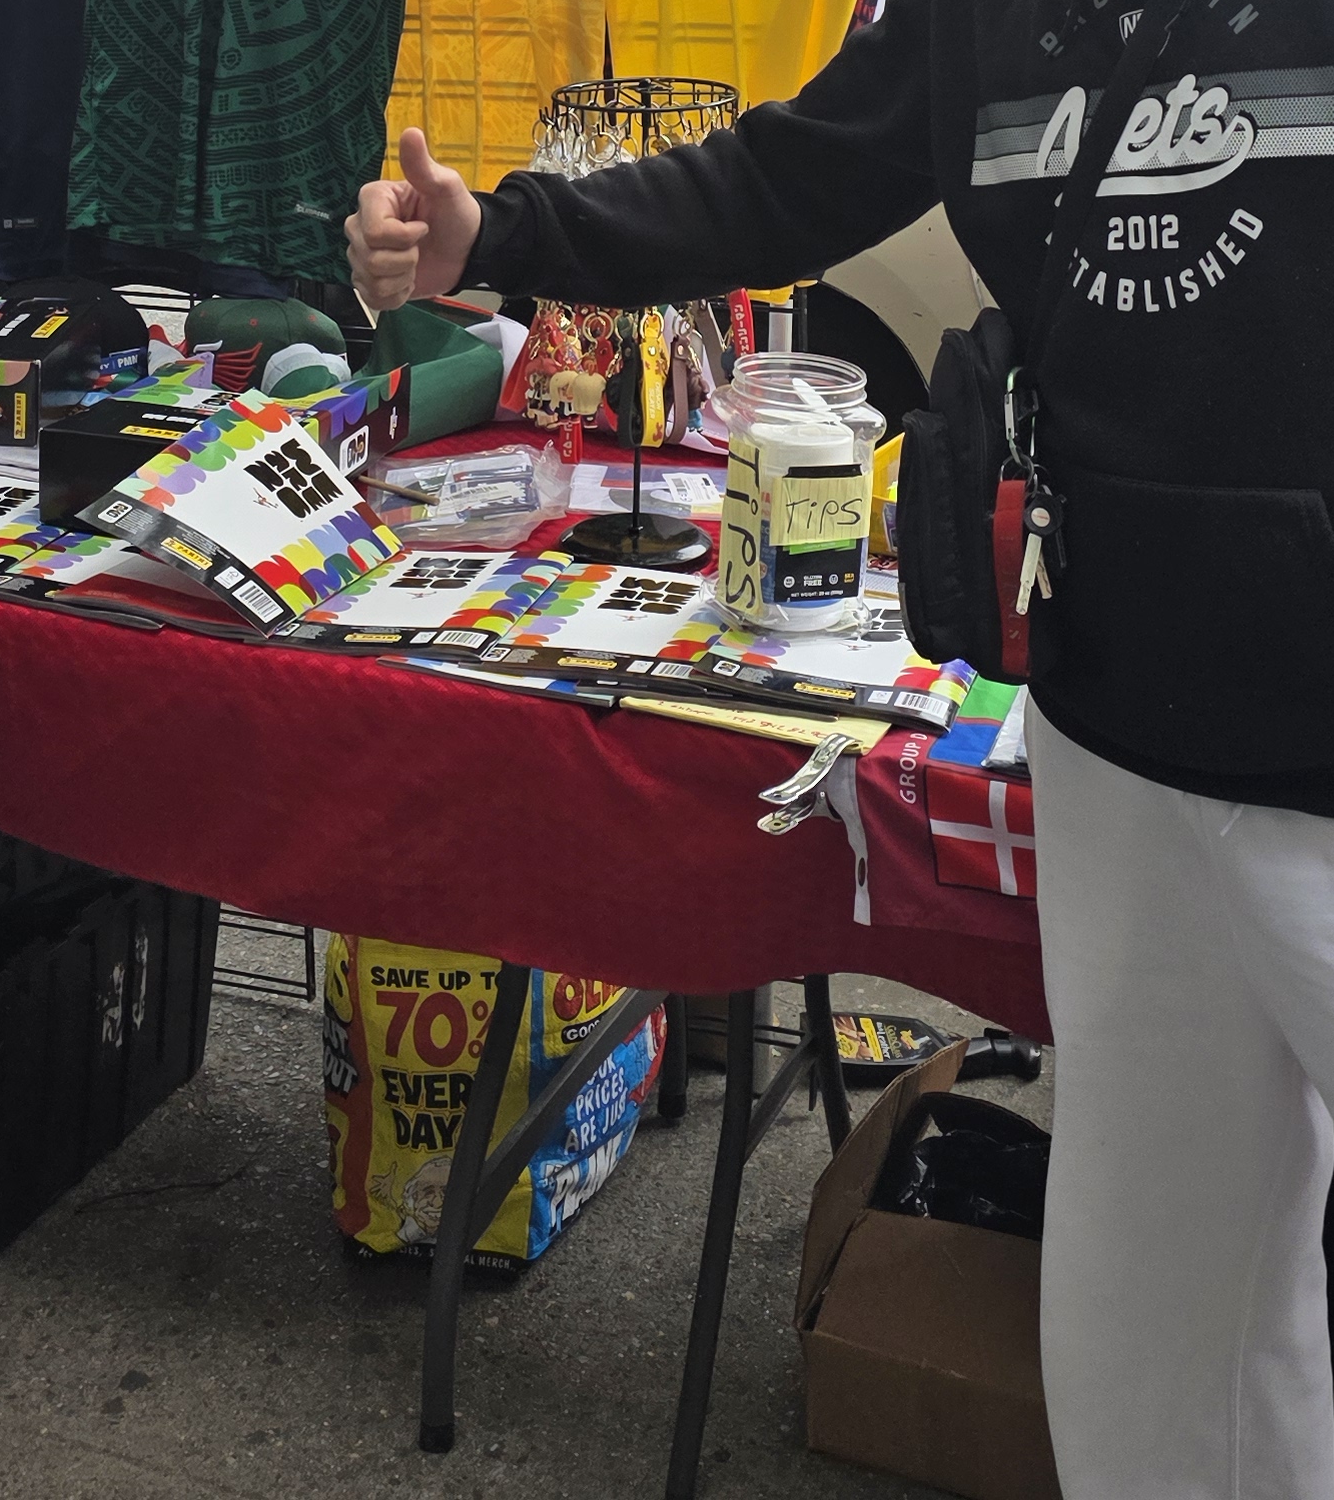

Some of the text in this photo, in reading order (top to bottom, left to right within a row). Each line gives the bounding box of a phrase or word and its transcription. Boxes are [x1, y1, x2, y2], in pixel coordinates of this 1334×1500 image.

[1107, 213, 1180, 251] 2012
[15, 395, 23, 427] PANINI
[176, 545, 211, 567] PANINI
[899, 733, 928, 805] GROUP D
[371, 966, 499, 991] SAVE UP T
[376, 990, 495, 1069] 70%
[575, 1066, 625, 1121] PRICES
[392, 1111, 465, 1150] DAY
[565, 1086, 629, 1155] ARE JUST
